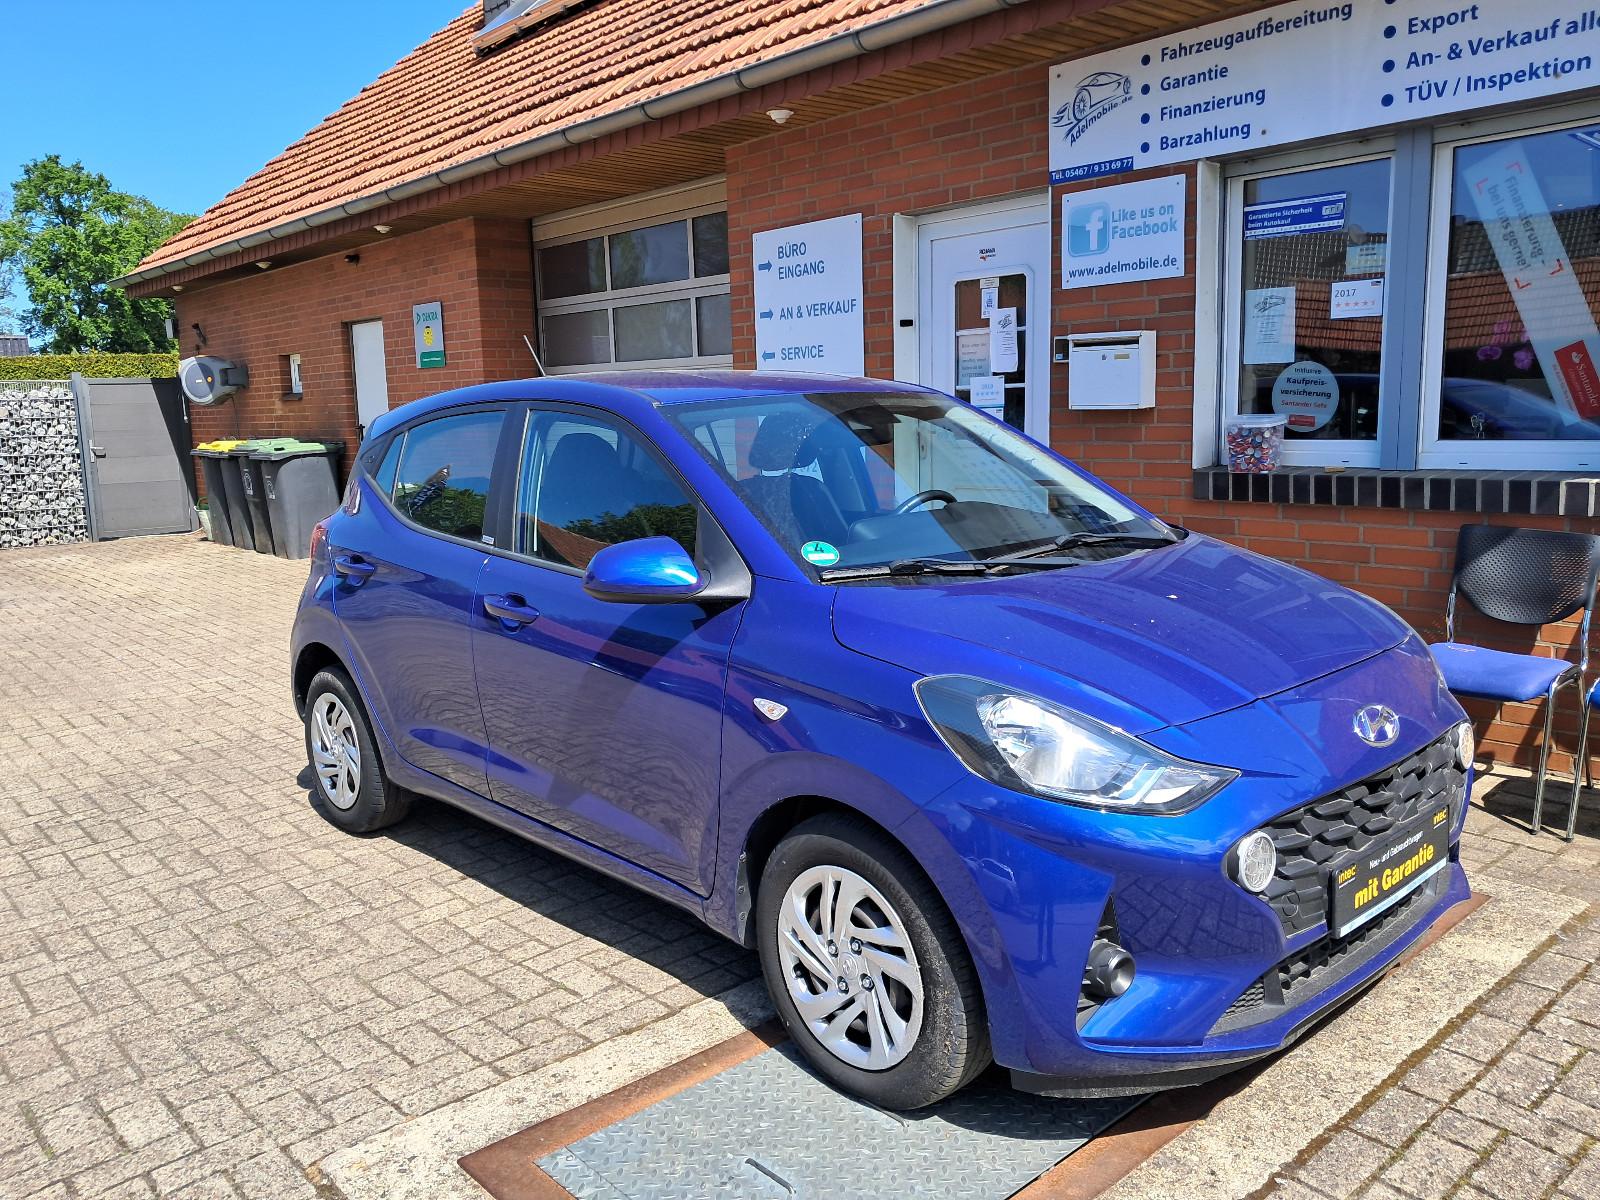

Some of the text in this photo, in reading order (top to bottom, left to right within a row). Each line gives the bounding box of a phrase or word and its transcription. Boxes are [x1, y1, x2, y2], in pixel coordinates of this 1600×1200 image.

[1407, 4, 1479, 35] Export
[1161, 4, 1352, 62] Fahrzeugaufbereitung
[1406, 51, 1442, 69] An-
[1447, 42, 1463, 61] &
[1468, 18, 1561, 56] Verkauf
[1160, 64, 1229, 91] Garantie
[1405, 55, 1591, 103] TÜV / Inspektion
[1160, 88, 1266, 121] Finanzierung
[1070, 96, 1133, 147] Adelmobile.de
[1160, 123, 1251, 151] Barzahlung
[1065, 166, 1088, 178] 05467
[1094, 164, 1099, 173] 9
[1100, 162, 1110, 172] 33
[1111, 161, 1121, 170] 69
[1123, 159, 1132, 168] 77
[1112, 204, 1174, 222] Like us on
[1263, 218, 1291, 227] Autokauf
[1282, 207, 1313, 217] Sicherheit
[1112, 217, 1178, 240] Facebook
[778, 242, 807, 259] BÜRO
[778, 260, 825, 280] EINGANG
[1069, 255, 1177, 278] www.adelmobile.de
[1335, 289, 1357, 298] 2017
[780, 299, 857, 320] AN & VERKAUF
[780, 345, 825, 361] SERVICE
[1286, 377, 1328, 386] Kaufpreis-
[1280, 389, 1332, 400] versicherung
[814, 543, 825, 553] 4
[1354, 877, 1379, 909] mit
[1382, 843, 1434, 891] Garantie
